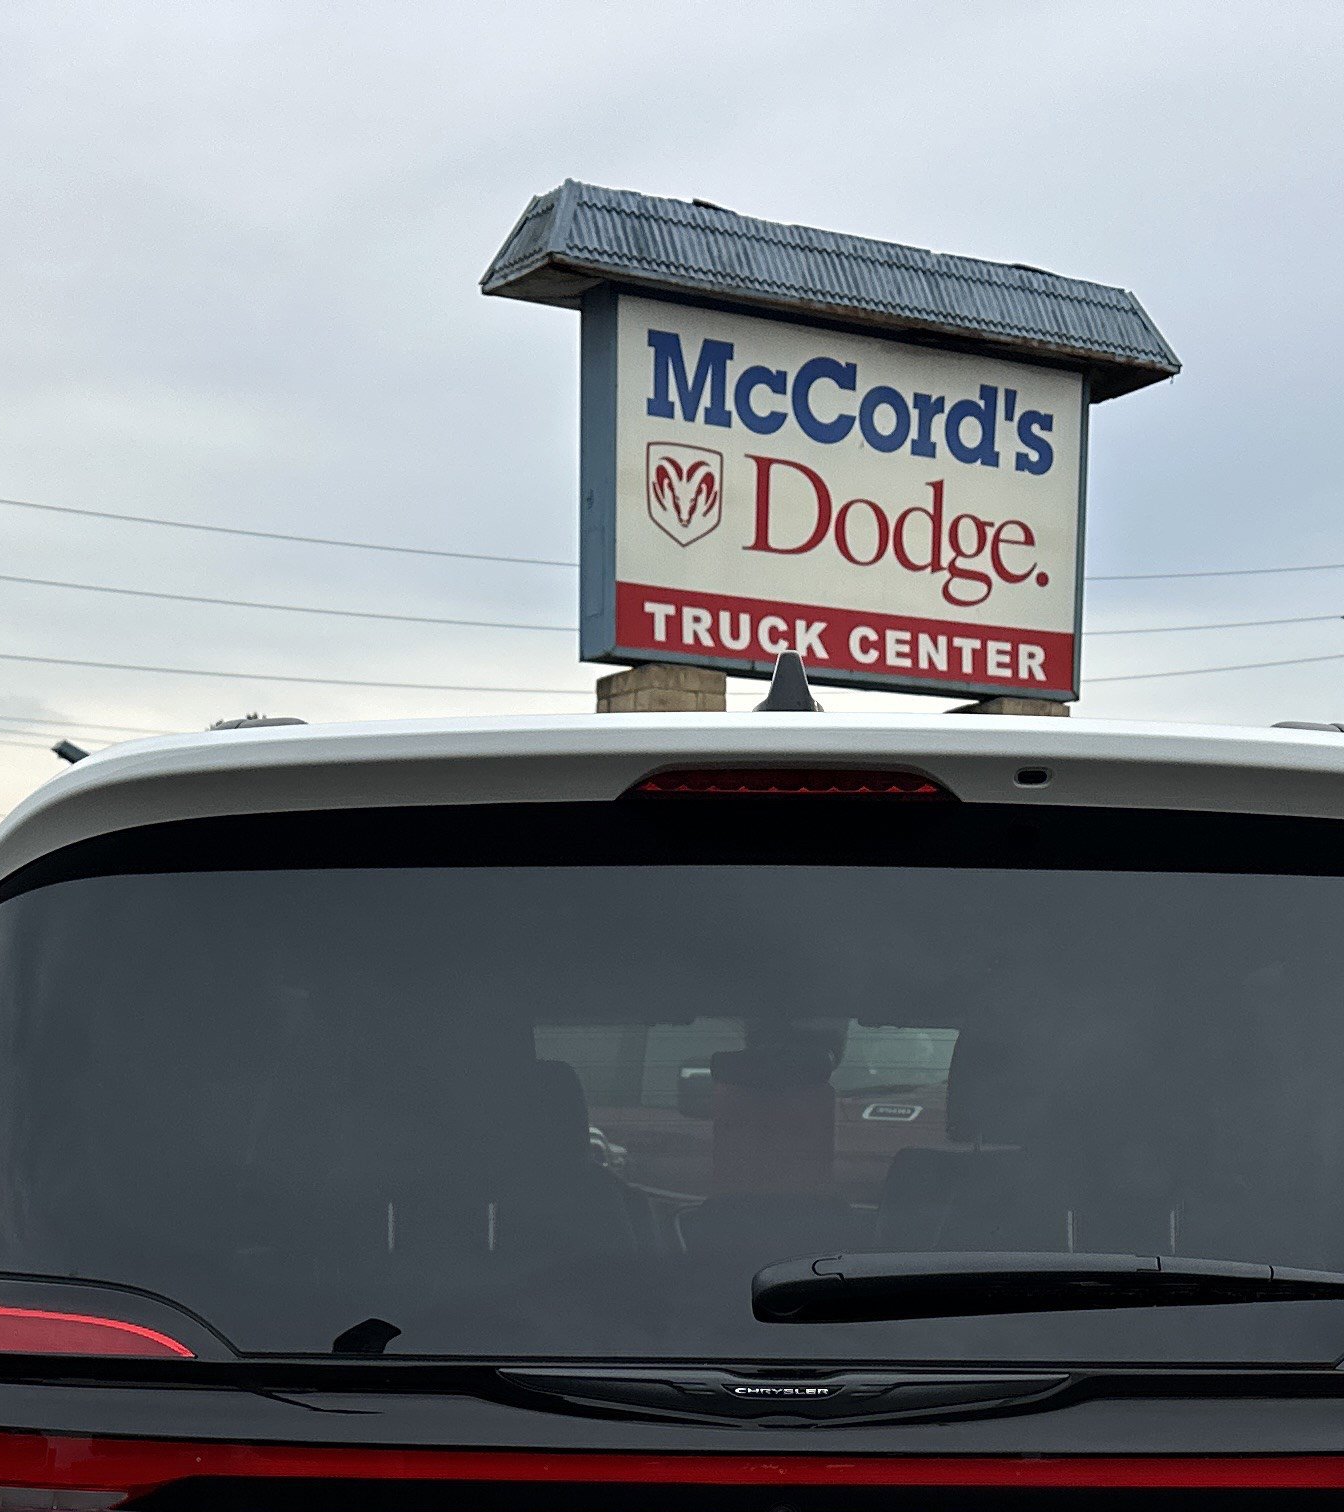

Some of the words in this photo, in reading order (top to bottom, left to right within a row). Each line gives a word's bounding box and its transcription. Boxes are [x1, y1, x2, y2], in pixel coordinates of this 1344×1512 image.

[646, 328, 1056, 476] McCord's
[644, 602, 830, 660] TRUCK
[848, 626, 1048, 682] CENTER
[734, 1387, 829, 1395] CHRYSLER
